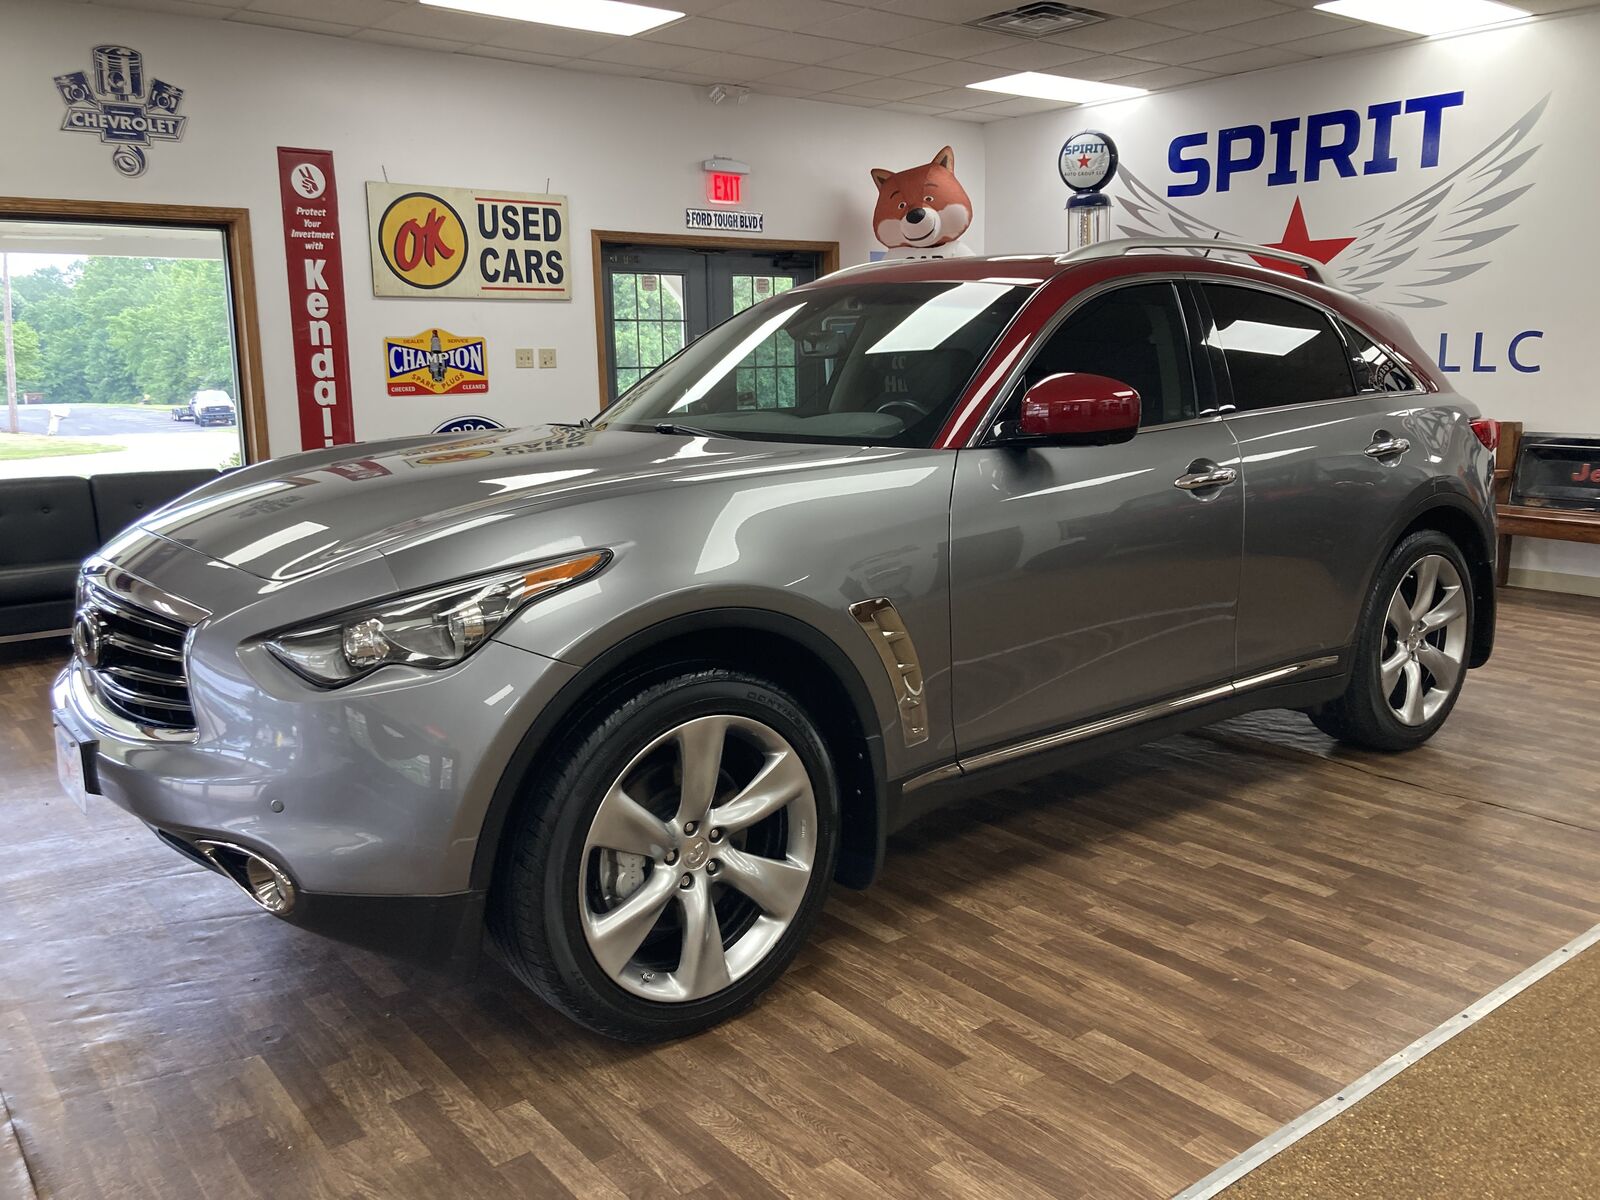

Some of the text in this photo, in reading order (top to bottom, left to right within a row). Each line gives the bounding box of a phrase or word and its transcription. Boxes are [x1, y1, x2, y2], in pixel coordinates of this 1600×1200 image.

[71, 112, 176, 134] CHEVROLET
[1064, 143, 1106, 155] SPIRIT
[1167, 90, 1465, 198] SPIRIT
[713, 174, 741, 202] EXIT
[296, 206, 327, 217] Protect
[303, 218, 322, 228] Your
[477, 203, 562, 242] USED
[691, 211, 758, 229] FORD TOUGH BLVD
[290, 229, 335, 240] Investment
[304, 241, 324, 250] with
[393, 207, 455, 272] OK
[479, 247, 564, 285] CARS
[304, 258, 337, 448] Kendal
[389, 344, 483, 374] CHAMPION
[1438, 330, 1544, 373] LLC
[411, 372, 465, 390] SPARK PLUGS
